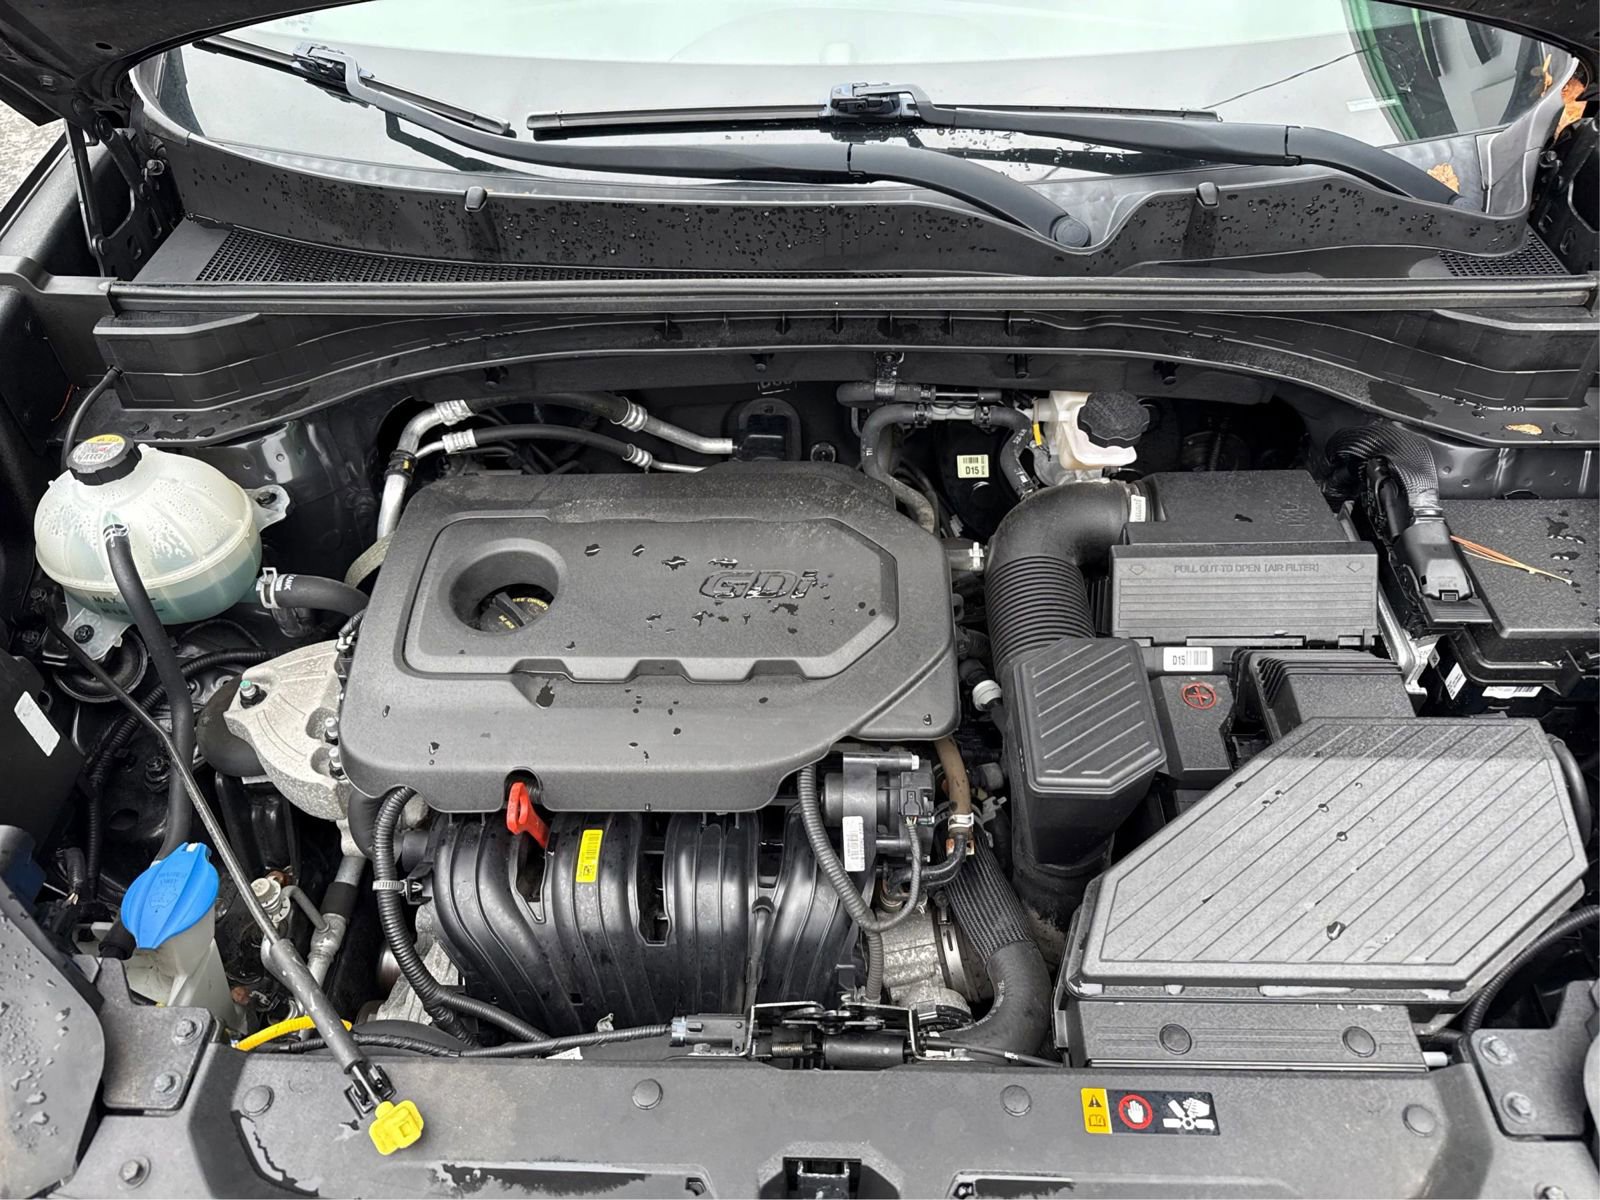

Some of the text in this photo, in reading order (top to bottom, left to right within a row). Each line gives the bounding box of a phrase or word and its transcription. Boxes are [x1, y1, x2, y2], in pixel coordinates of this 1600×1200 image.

[965, 466, 980, 475] D15
[1174, 564, 1199, 574] PULL
[1200, 564, 1219, 573] OUT
[1220, 564, 1234, 573] TO
[1235, 563, 1261, 573] OPEN
[1172, 655, 1186, 666] D15
